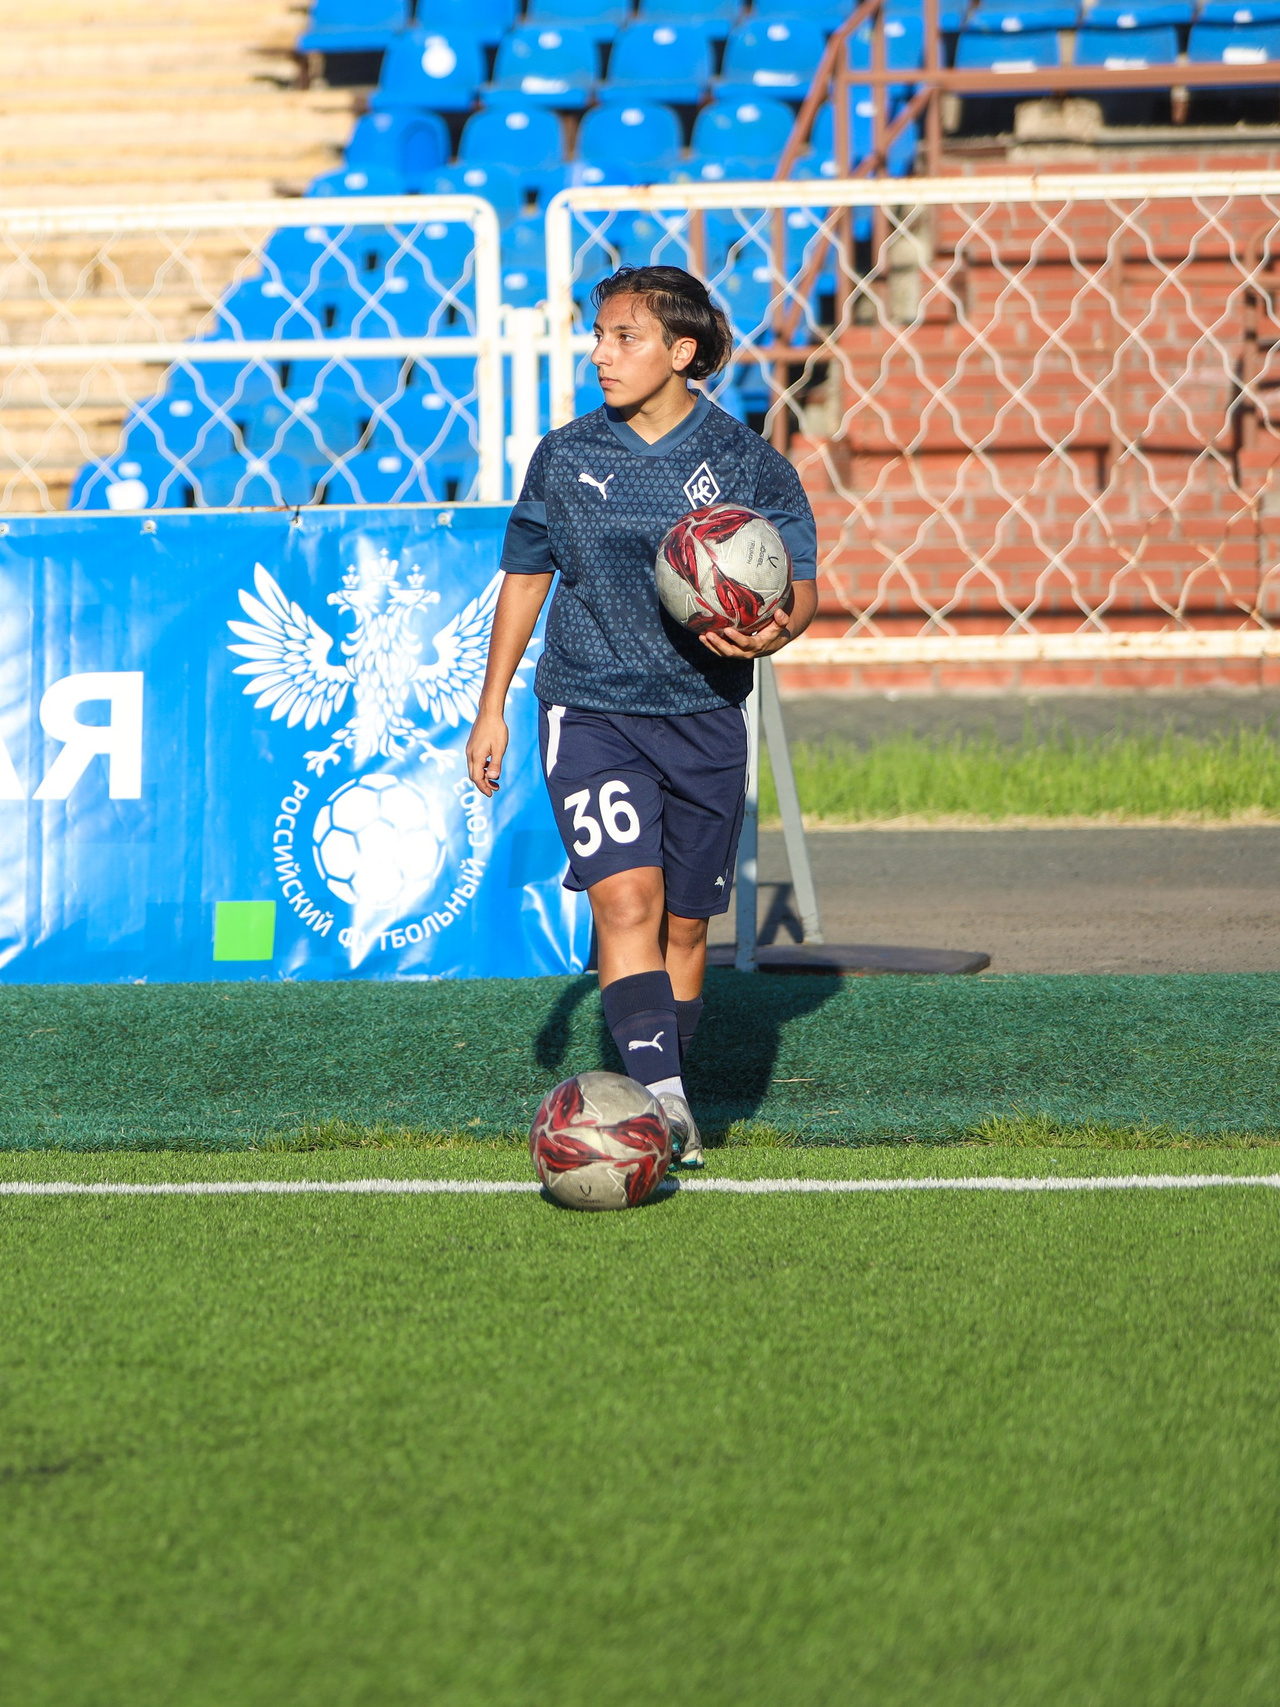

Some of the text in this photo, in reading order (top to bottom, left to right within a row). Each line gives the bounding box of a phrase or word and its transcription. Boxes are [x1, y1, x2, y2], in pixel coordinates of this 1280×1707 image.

[272, 780, 334, 938] РОССИЙСКИЙ
[337, 858, 486, 951] ФТБОЛЬНЫЙ
[564, 780, 641, 858] 36
